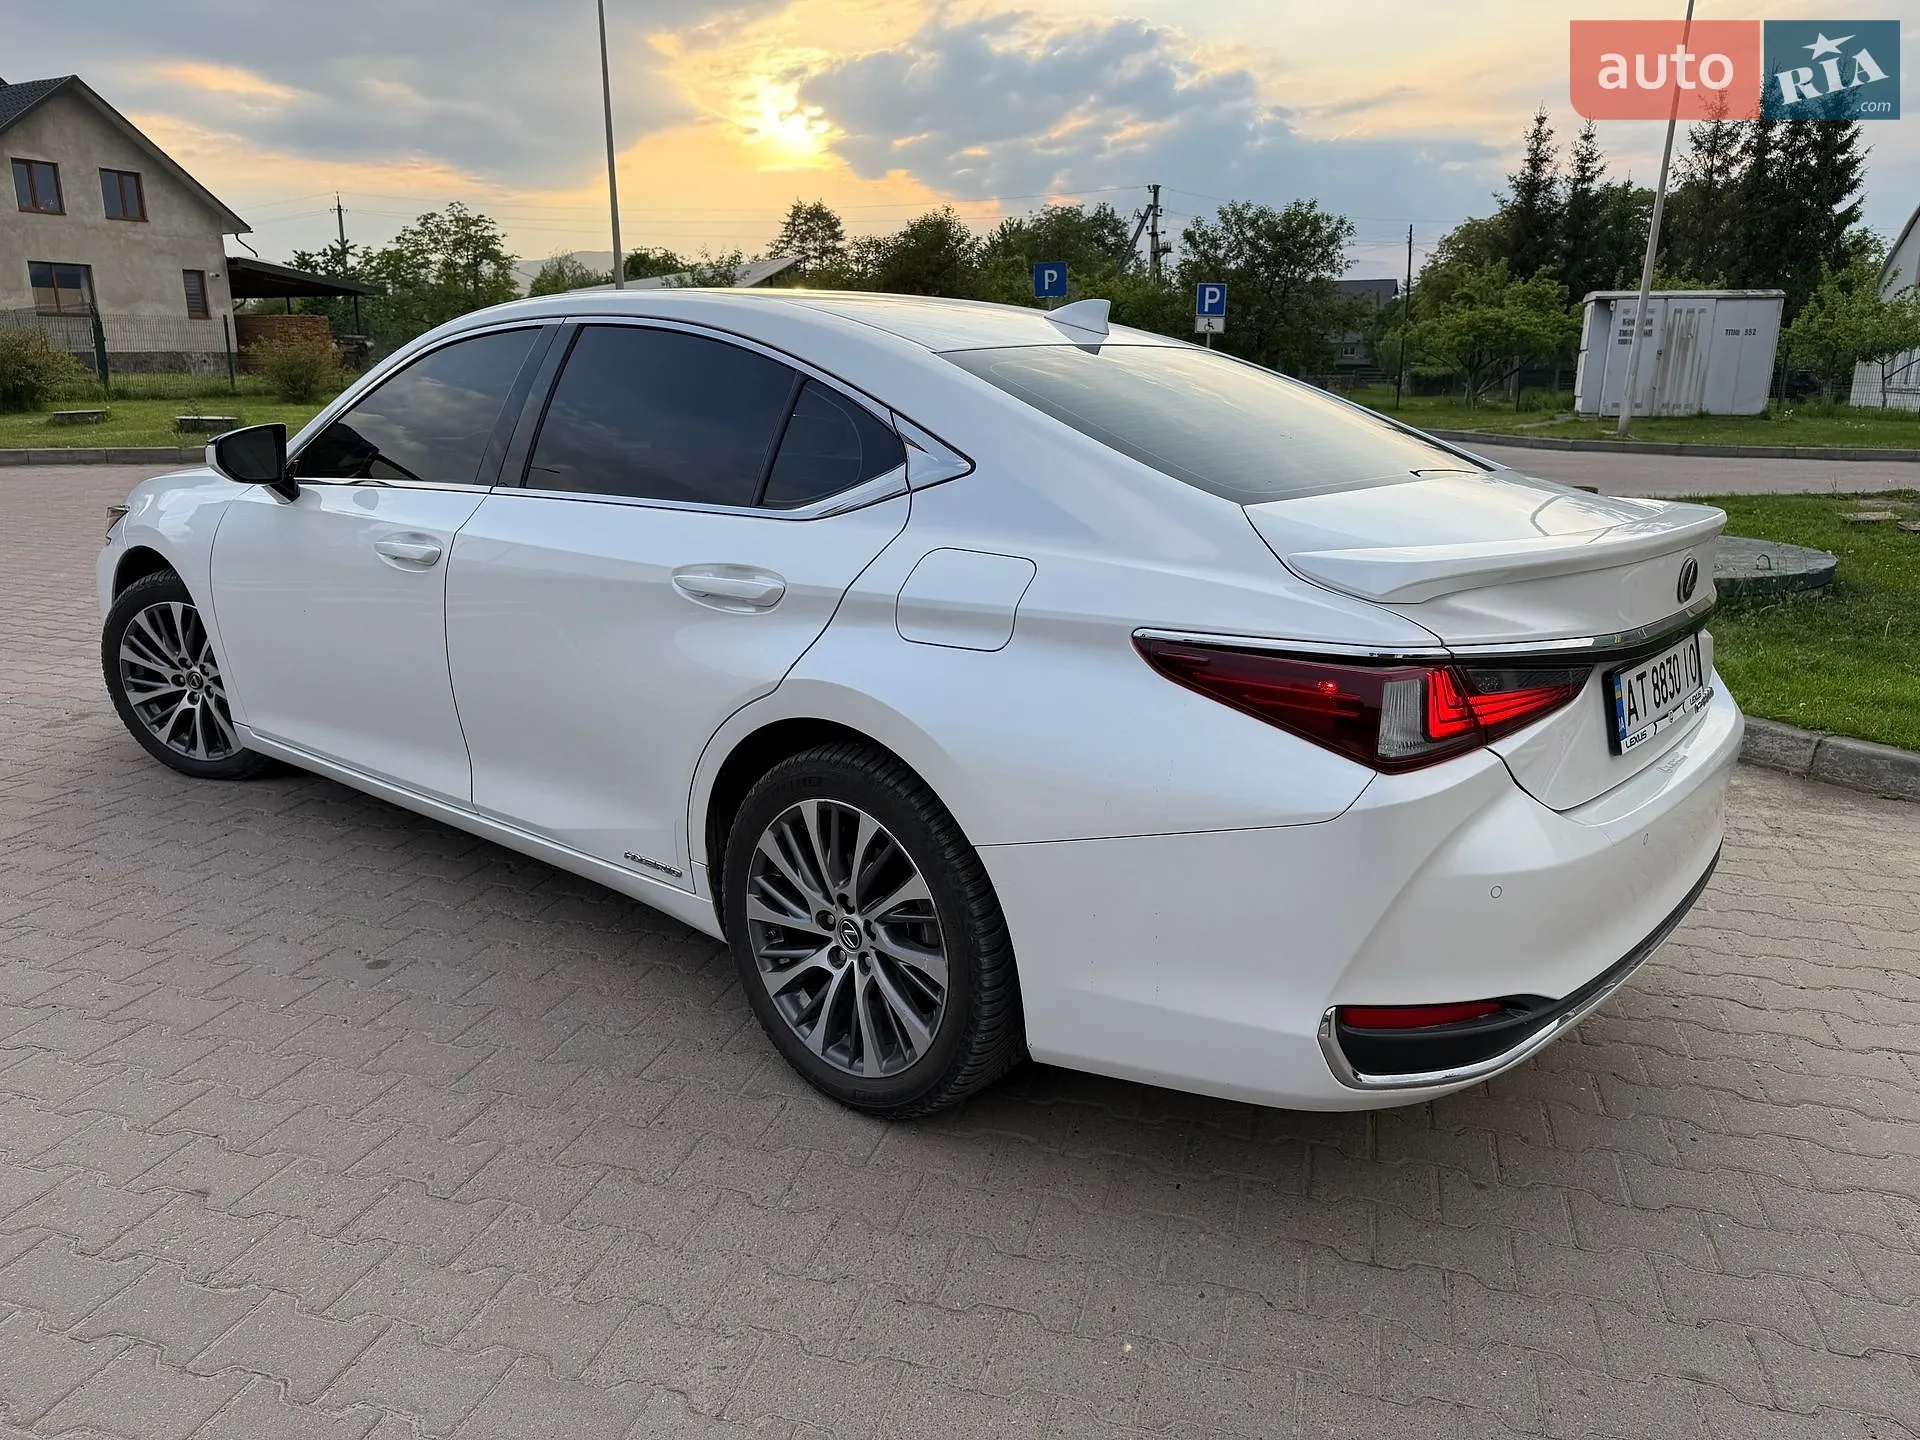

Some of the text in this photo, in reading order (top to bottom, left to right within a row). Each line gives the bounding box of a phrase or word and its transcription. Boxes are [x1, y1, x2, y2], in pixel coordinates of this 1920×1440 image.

[1044, 270, 1057, 290] P
[1204, 287, 1220, 312] P
[1627, 670, 1647, 726] AT
[1651, 653, 1681, 709] 8830
[1625, 730, 1648, 749] LEXUS
